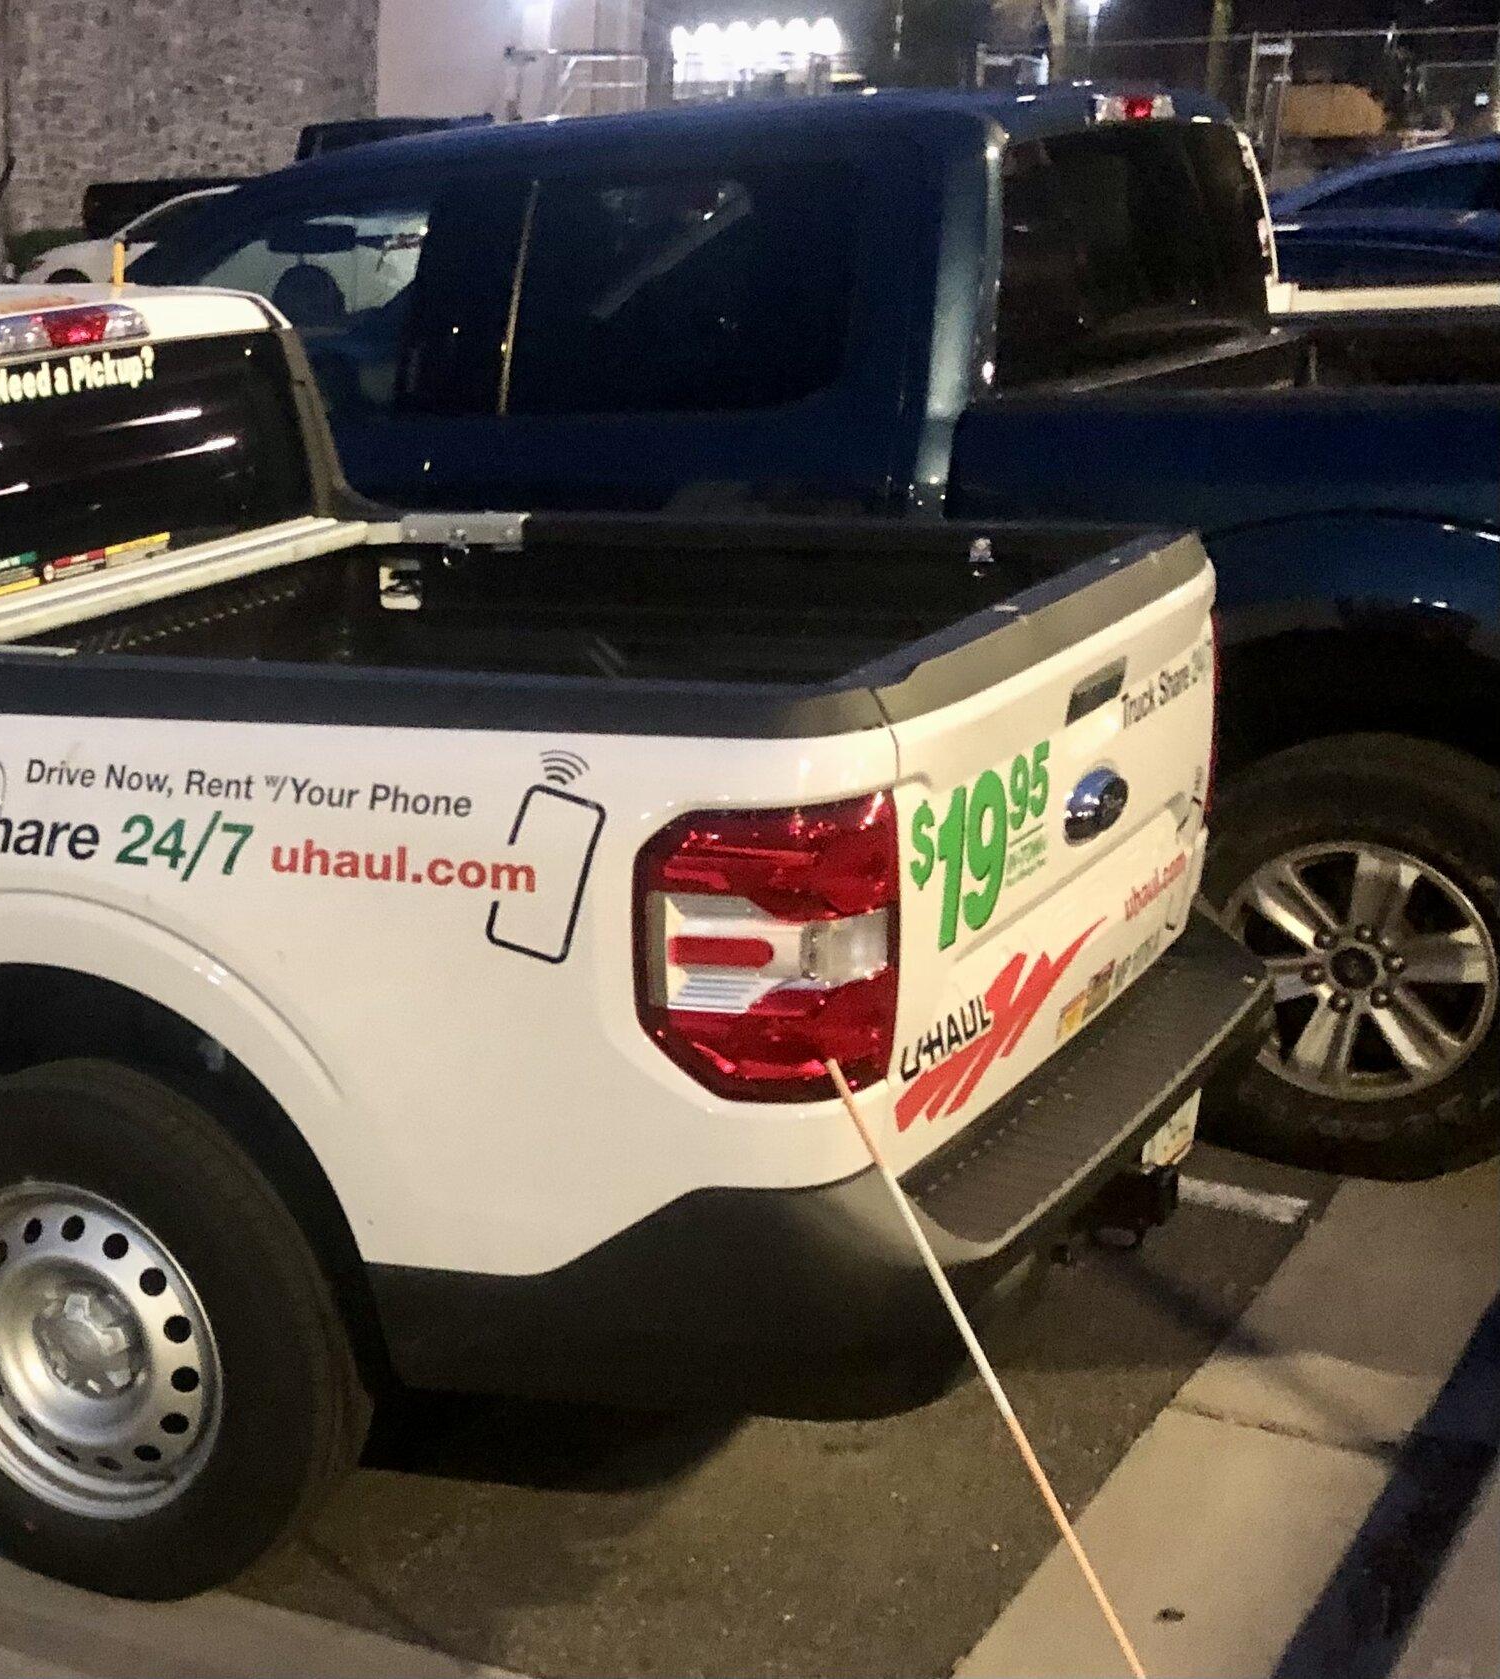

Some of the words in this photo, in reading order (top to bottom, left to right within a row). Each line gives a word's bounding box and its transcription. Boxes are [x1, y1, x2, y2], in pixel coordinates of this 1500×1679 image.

[53, 366, 70, 396] a
[69, 344, 155, 392] Pickup?
[26, 758, 96, 788] Drive
[104, 763, 173, 799] Now,
[184, 768, 255, 801] Rent
[368, 783, 473, 818] Phone
[114, 810, 255, 883] 24/7
[271, 838, 537, 893] uhaul.com
